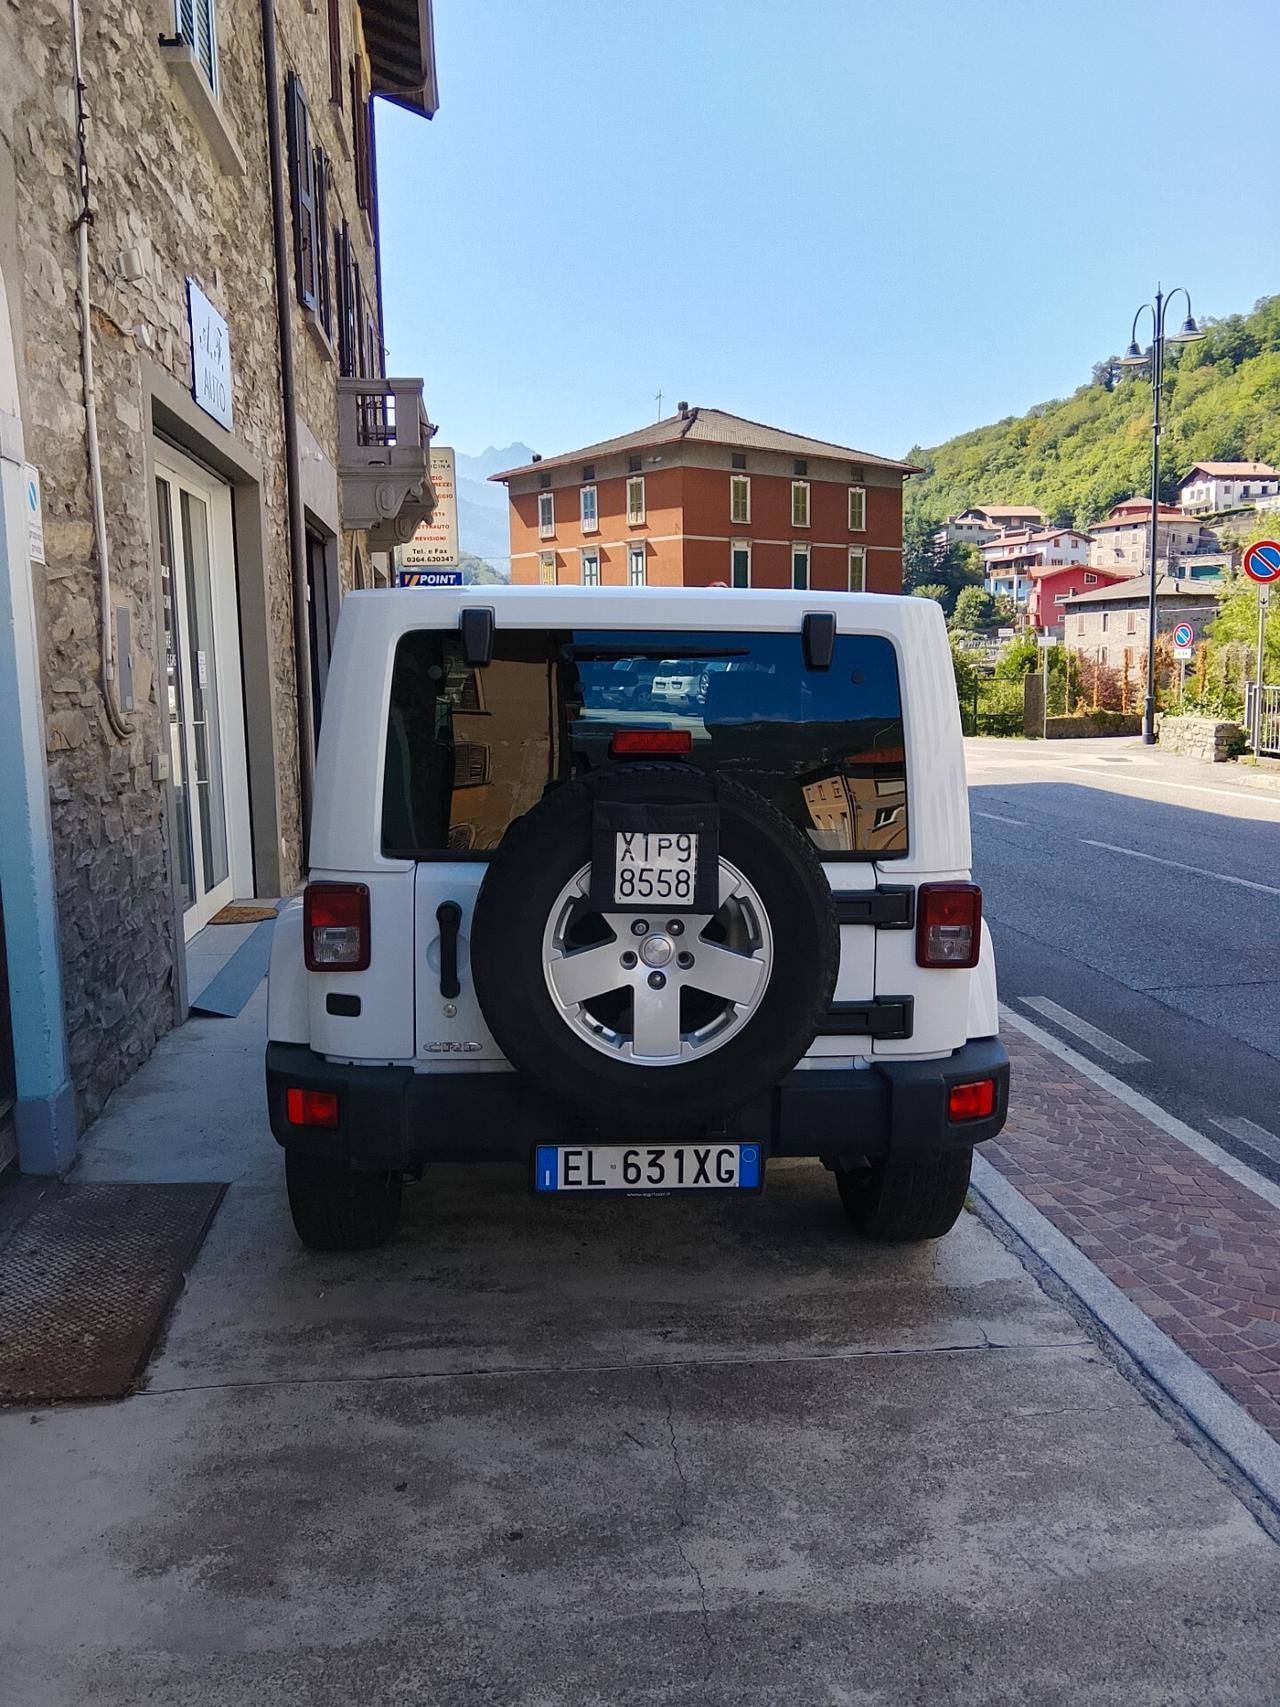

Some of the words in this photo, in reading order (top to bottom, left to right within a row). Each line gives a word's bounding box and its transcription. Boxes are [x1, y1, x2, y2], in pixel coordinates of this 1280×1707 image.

[204, 367, 226, 413] AUTO
[420, 574, 456, 585] POINT
[620, 868, 691, 898] 8558
[423, 1041, 483, 1053] CRD
[563, 1150, 607, 1186] EL
[622, 1148, 736, 1185] 631XG
